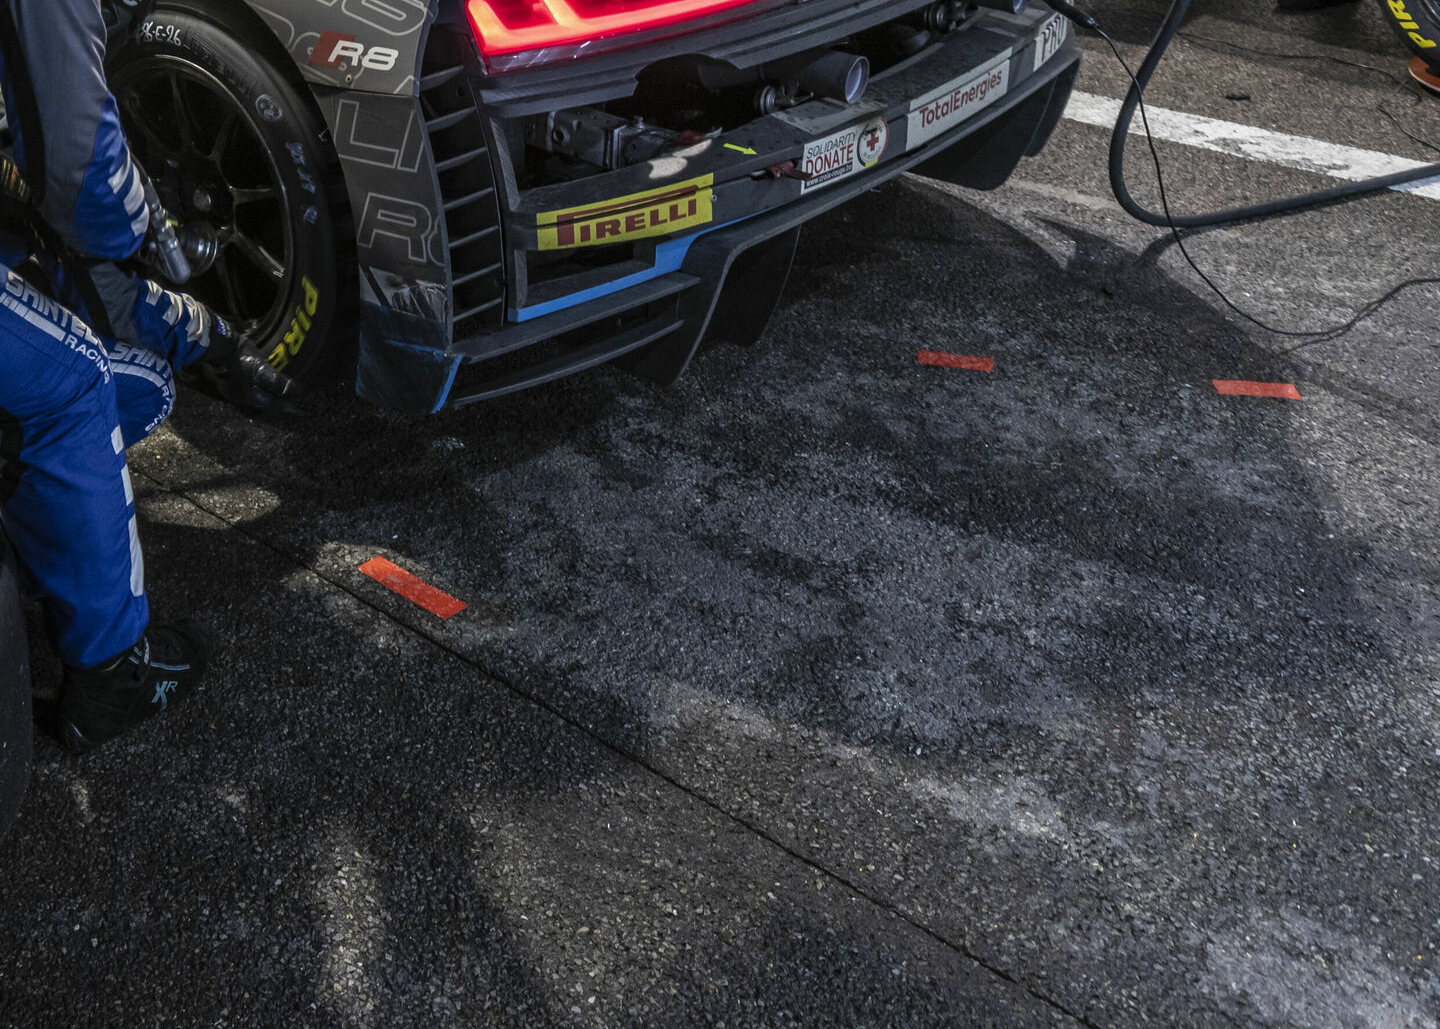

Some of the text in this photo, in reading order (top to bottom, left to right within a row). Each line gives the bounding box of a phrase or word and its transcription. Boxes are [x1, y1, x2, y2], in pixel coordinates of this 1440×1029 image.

[328, 40, 399, 71] R8
[919, 69, 1002, 128] TotalEnergies
[805, 143, 854, 176] DONATE
[806, 131, 858, 160] SOLIDARITY
[557, 184, 699, 247] PIRELLI
[268, 275, 319, 372] PIRE
[63, 333, 110, 385] RACING
